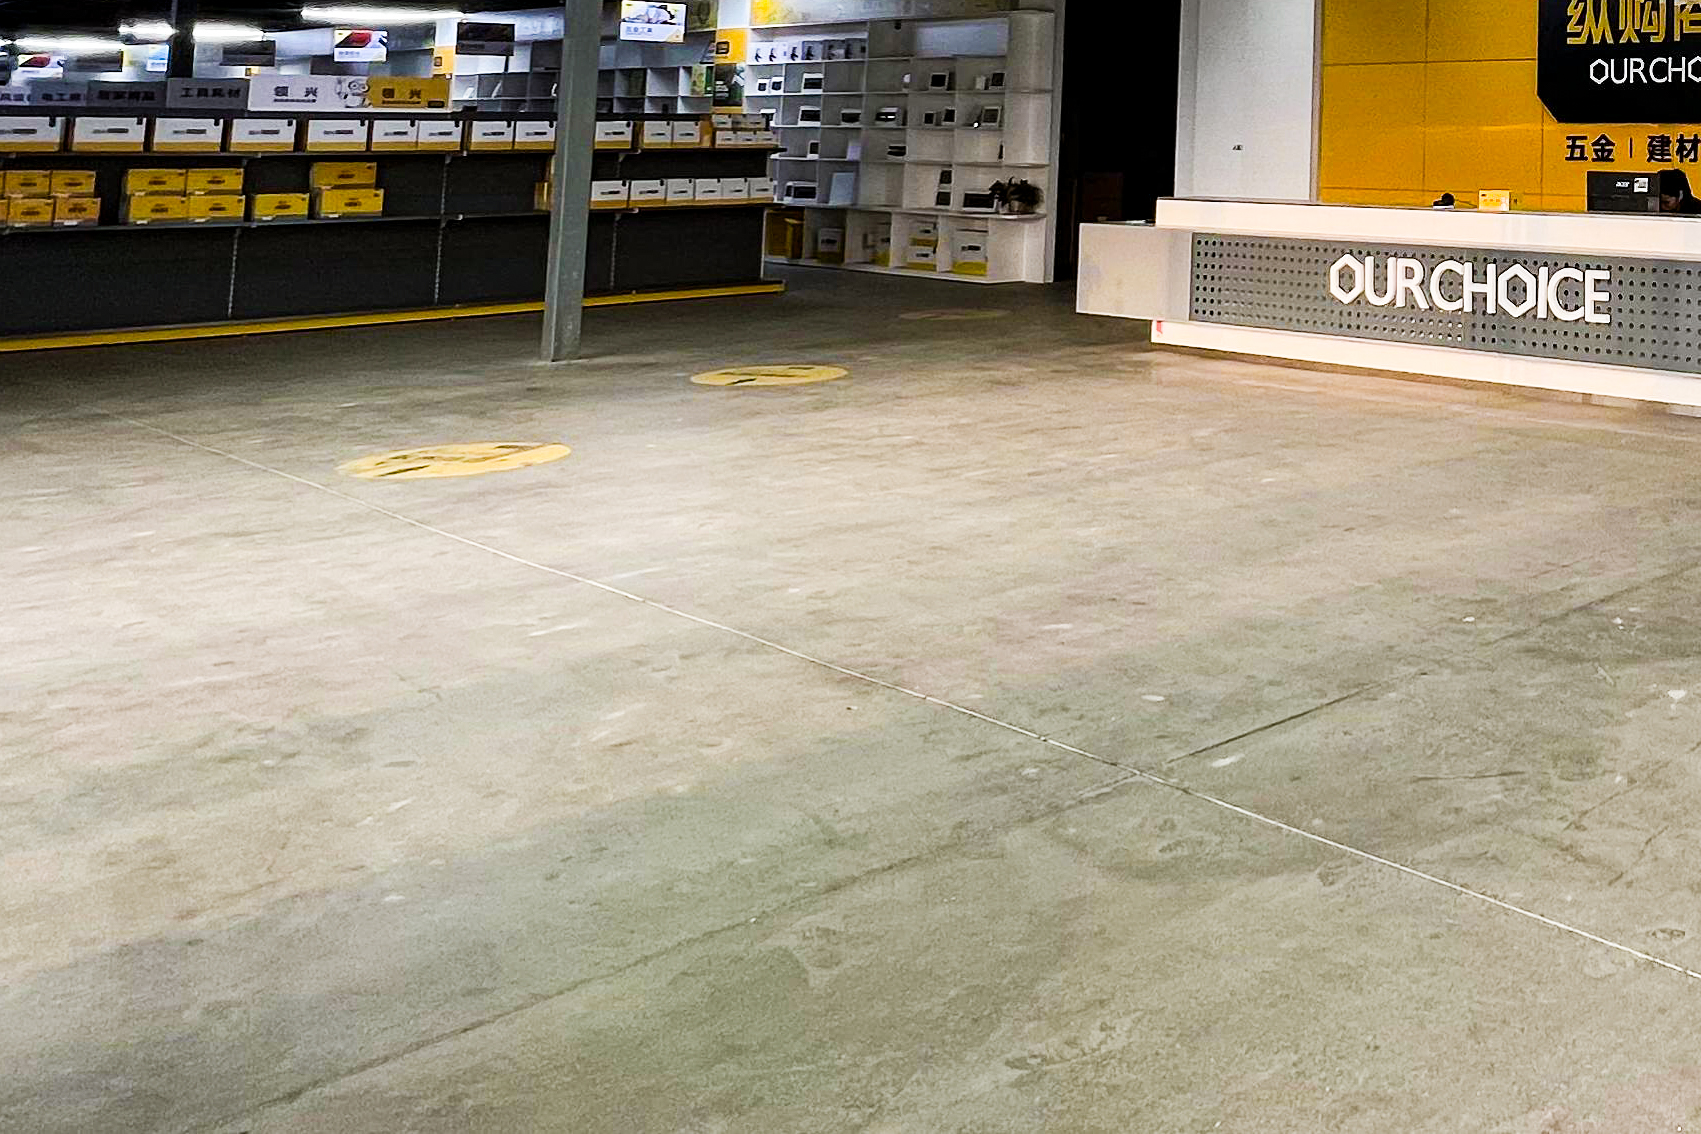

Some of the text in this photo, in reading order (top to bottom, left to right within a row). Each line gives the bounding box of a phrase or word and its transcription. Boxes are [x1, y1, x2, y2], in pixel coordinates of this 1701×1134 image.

[1564, 133, 1616, 164] 五金
[1646, 133, 1701, 164] 建材
[1329, 254, 1612, 325] OURCHOICE
